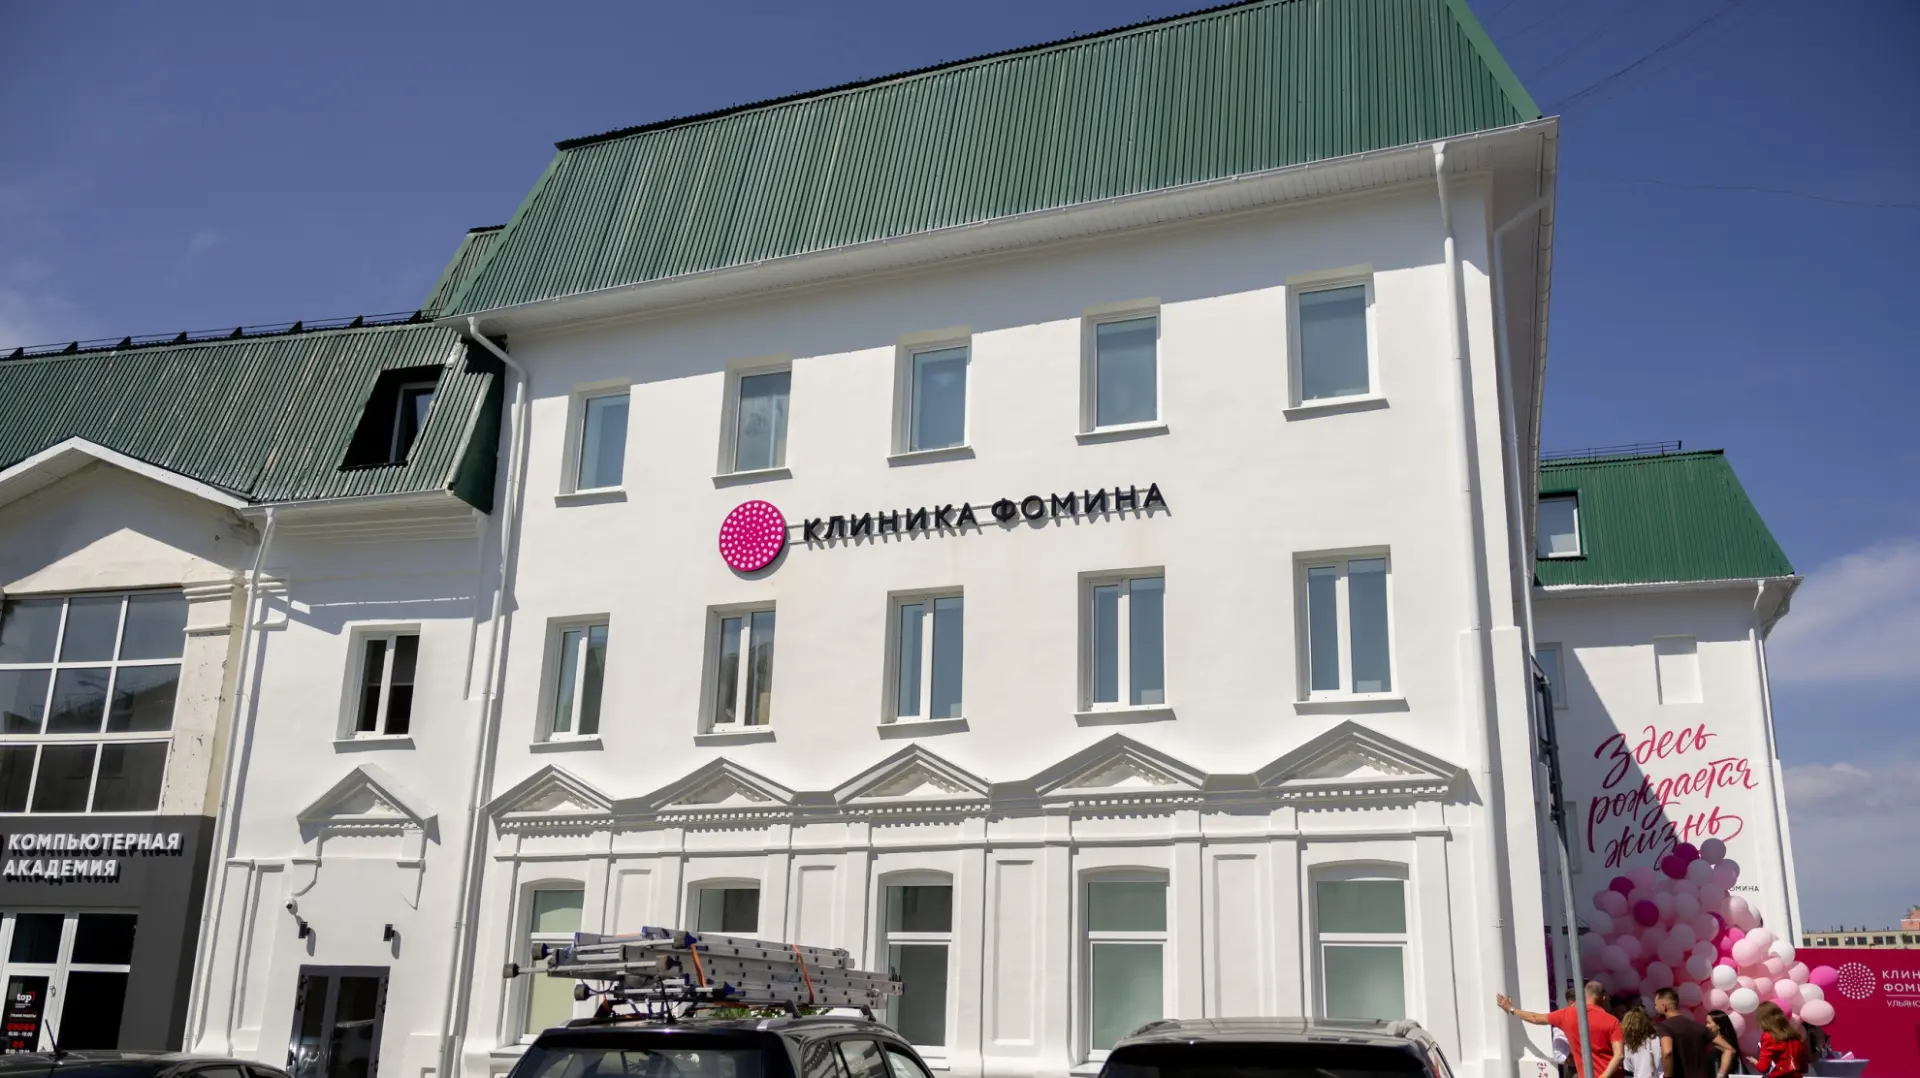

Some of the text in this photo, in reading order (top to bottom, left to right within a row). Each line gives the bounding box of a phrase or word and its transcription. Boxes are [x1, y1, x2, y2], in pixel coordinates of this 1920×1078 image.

[803, 482, 1167, 541] КЛИНИКА ФОМИНА
[1594, 724, 1717, 789] Здесь
[1587, 758, 1758, 853] рождается
[8, 833, 182, 851] КОМПЬЮТЕРНАЯ
[1604, 806, 1743, 871] жизнь
[3, 859, 118, 879] АКАДЕМИЯ
[17, 993, 32, 1003] top
